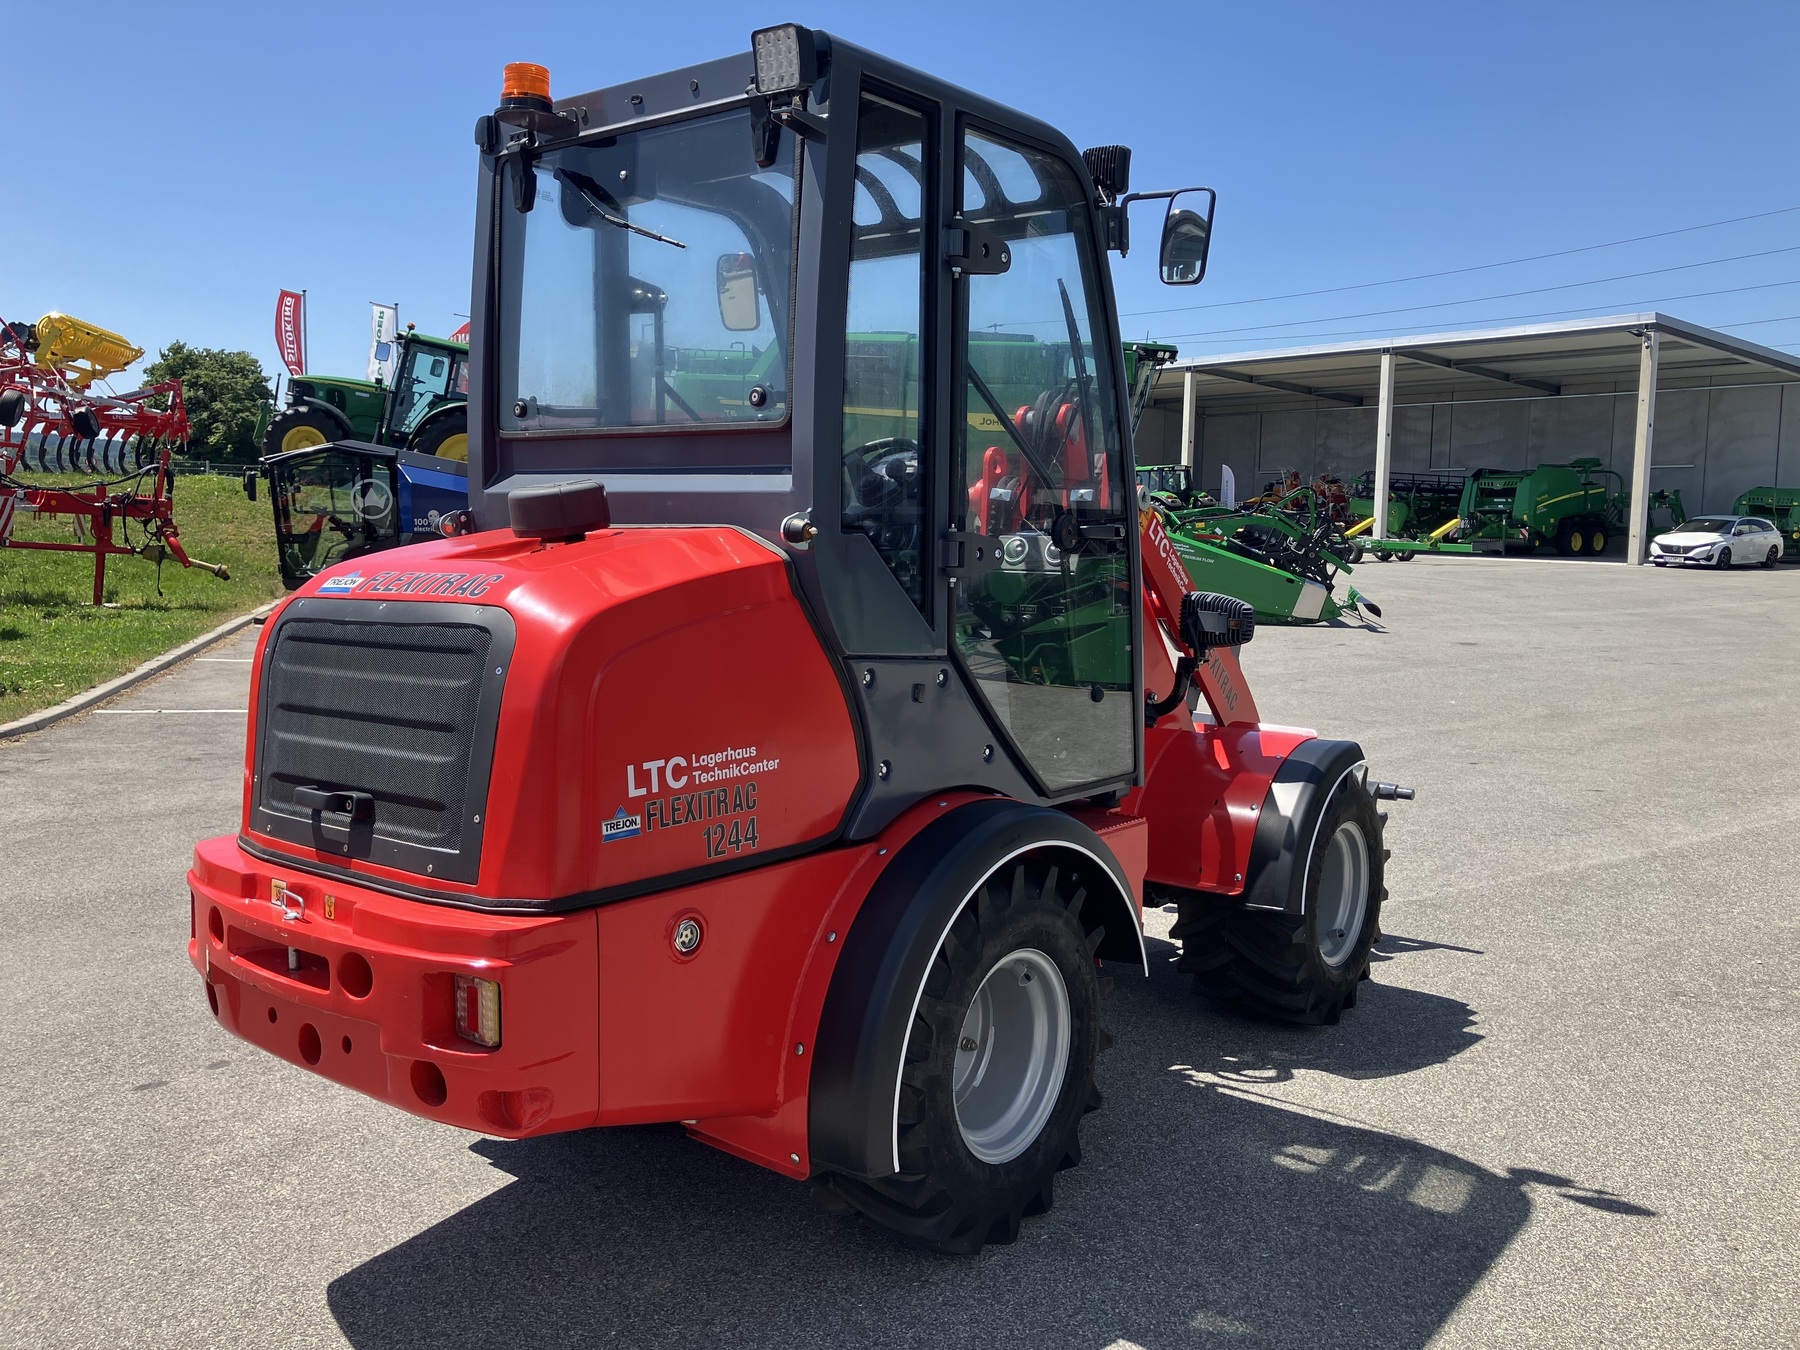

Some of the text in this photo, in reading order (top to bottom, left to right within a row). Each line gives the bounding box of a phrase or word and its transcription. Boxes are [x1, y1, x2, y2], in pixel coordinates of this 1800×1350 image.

[1148, 518, 1170, 558] LTC
[356, 570, 505, 599] FLEXITRAC
[627, 756, 688, 798] LTC
[692, 746, 757, 768] Lagerhaus
[692, 758, 780, 785] TechnikCenter
[645, 781, 758, 832] FLEXITRAC
[702, 816, 759, 860] 1244
